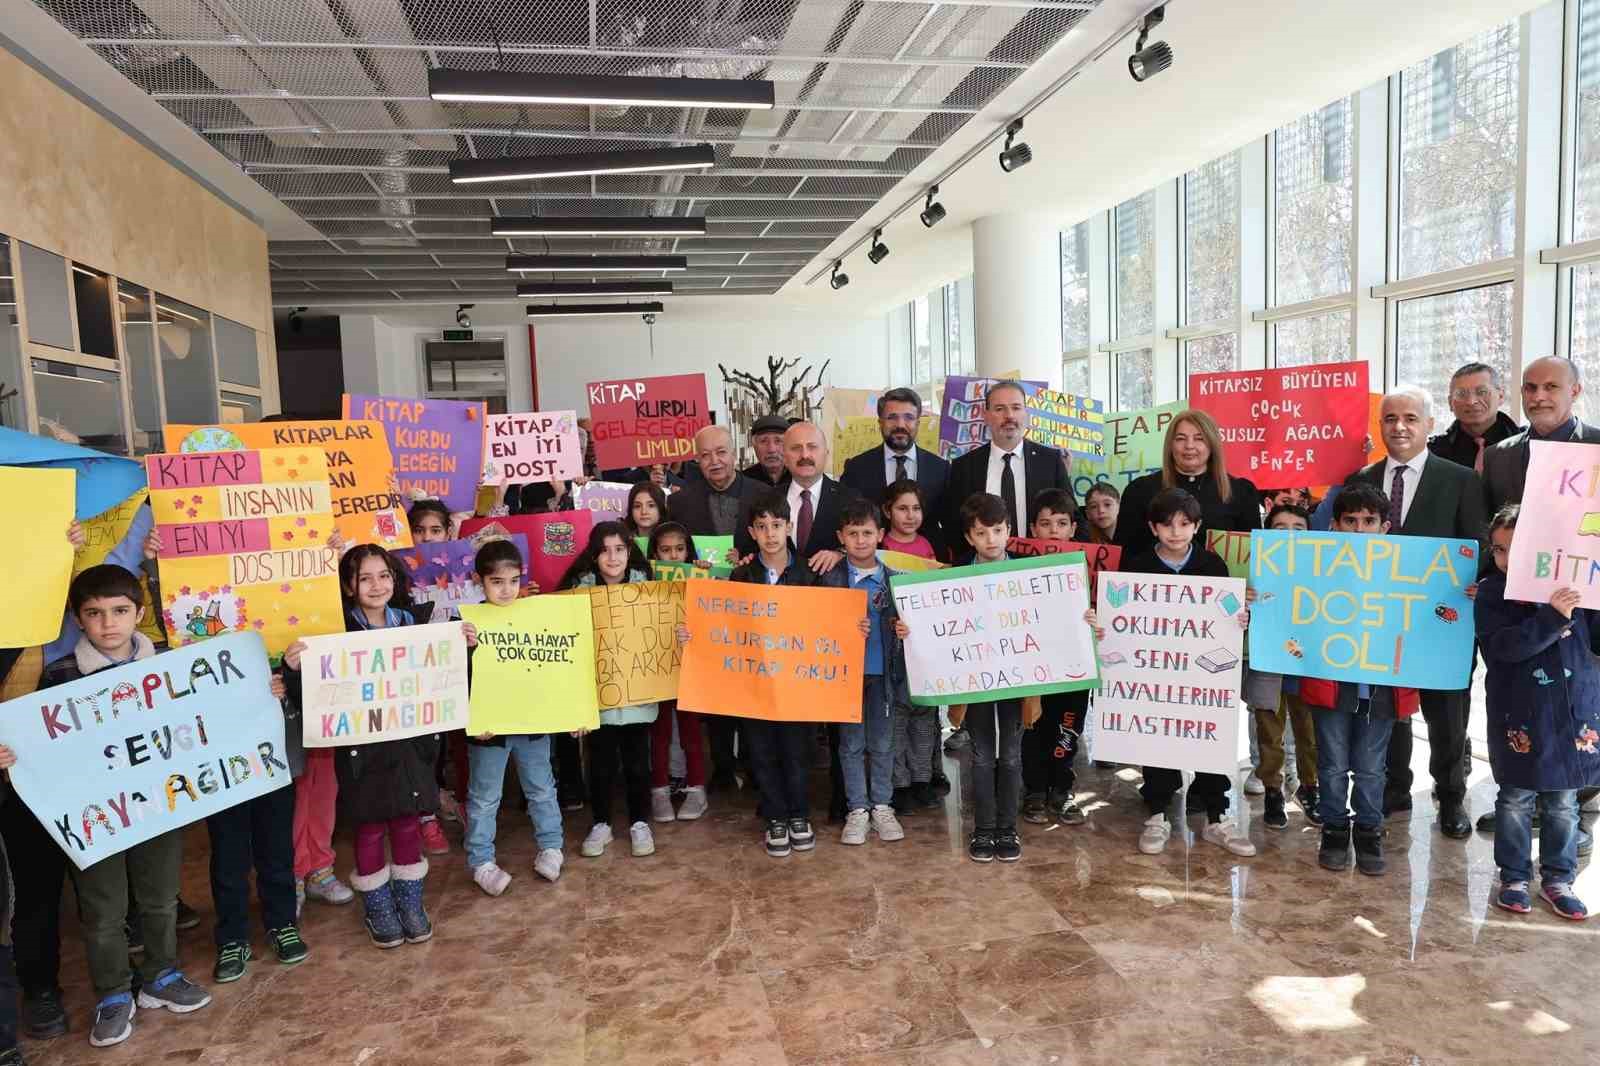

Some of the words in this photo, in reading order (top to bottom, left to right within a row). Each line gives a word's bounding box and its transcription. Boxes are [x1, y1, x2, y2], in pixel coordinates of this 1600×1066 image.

[589, 382, 646, 405] KİTAP
[1200, 376, 1264, 396] KİTAPSIZ
[1281, 370, 1357, 391] BÜYÜYEN
[364, 398, 425, 425] KİTAP
[635, 400, 696, 418] KURDU
[1251, 400, 1304, 421] ÇOCUK
[273, 424, 373, 444] KİTAPLAR
[395, 426, 451, 449] KURDU
[494, 416, 553, 437] KİTAP
[1219, 427, 1266, 442] SUSUZ
[1285, 424, 1344, 442] AĞACA
[491, 441, 517, 458] EN
[536, 435, 562, 454] İYİ
[159, 452, 247, 487] KİTAP
[326, 451, 353, 467] YA
[395, 452, 457, 473] ECEĞİN
[1250, 449, 1315, 472] BENZER
[225, 487, 314, 517] İNSANIN
[174, 527, 209, 554] EN
[216, 520, 247, 551] İYİ
[896, 584, 975, 612] TELEFON
[1292, 584, 1429, 632] DOST
[933, 615, 985, 637] UZAK
[1112, 615, 1216, 640] OKUMAK
[536, 633, 576, 648] HAYAT
